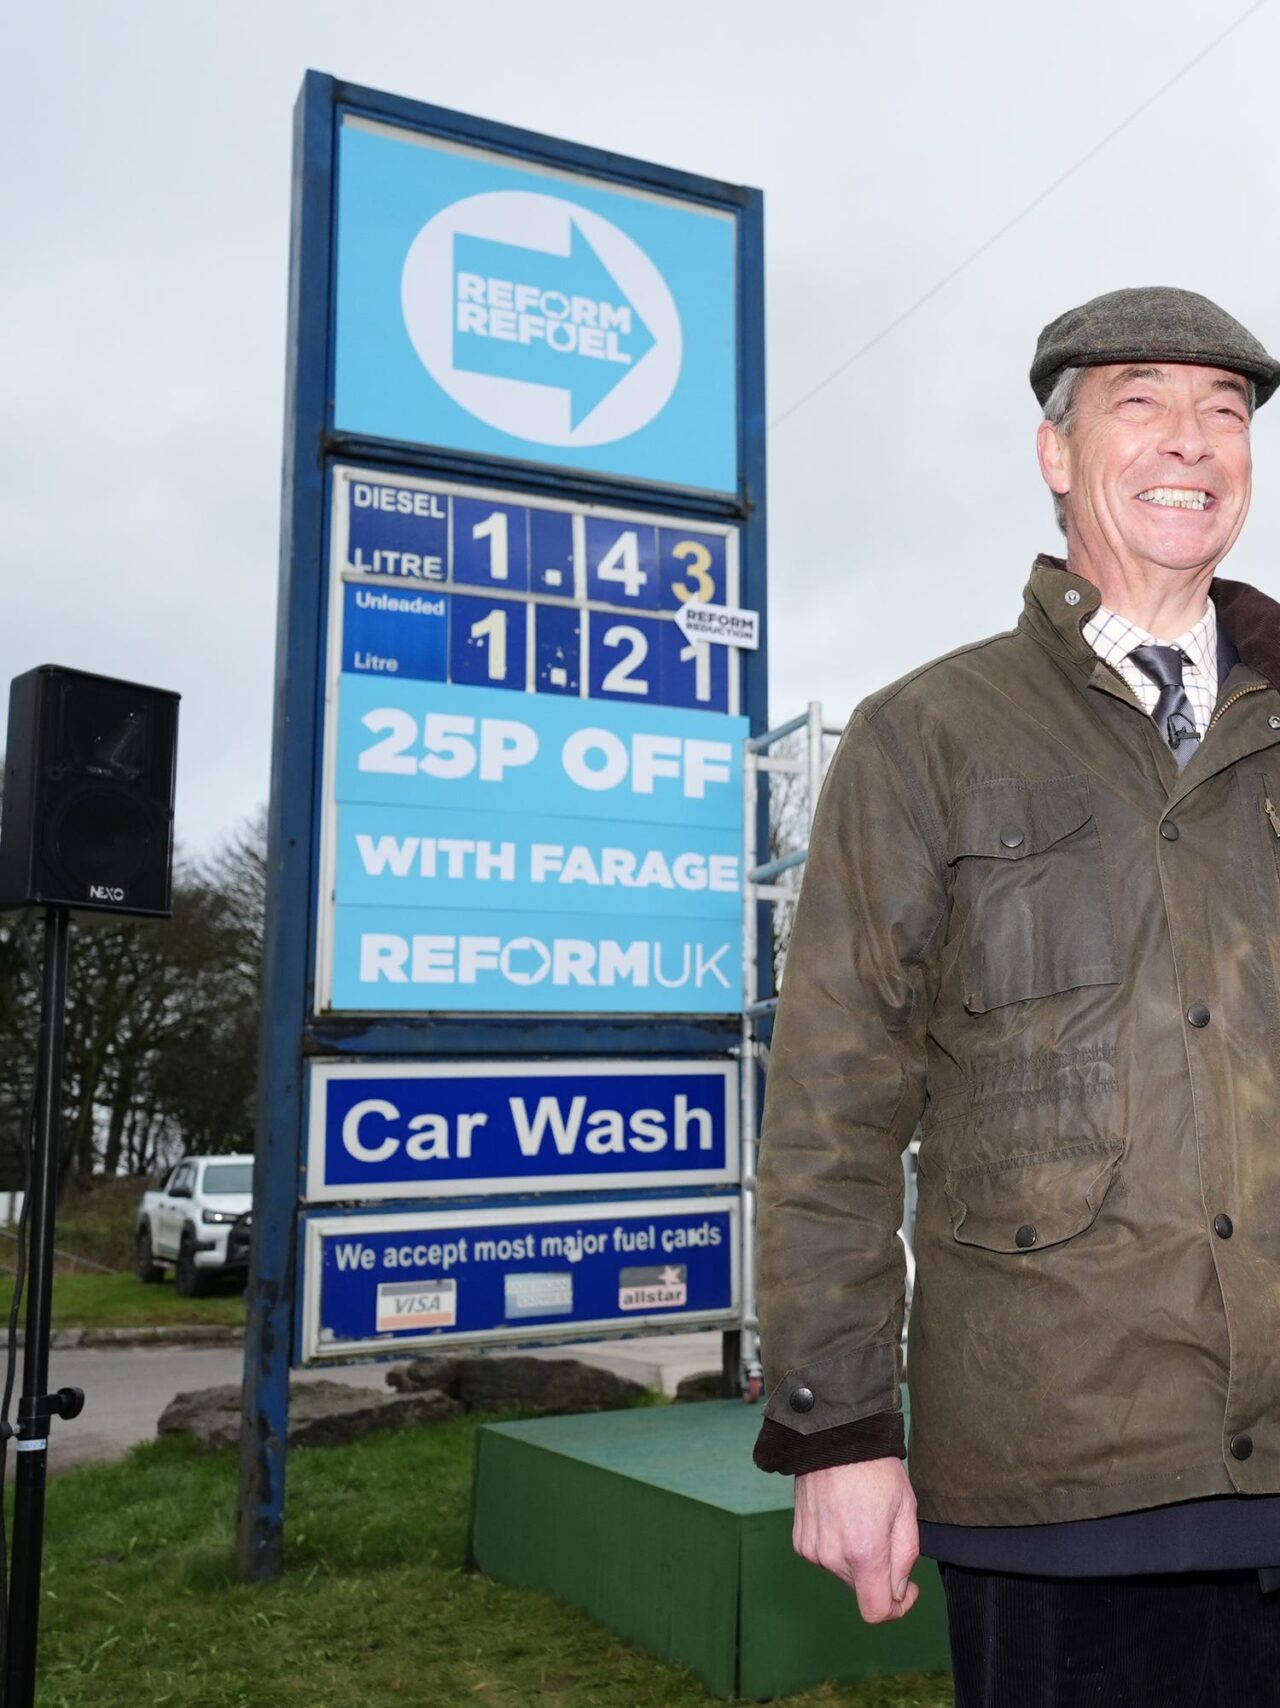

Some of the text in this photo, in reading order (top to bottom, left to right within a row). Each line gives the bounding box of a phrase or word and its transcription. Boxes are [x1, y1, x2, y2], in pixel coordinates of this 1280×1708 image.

[457, 271, 631, 333] REFORM
[457, 301, 631, 364] REFUEL
[354, 484, 445, 519] DIESEL
[354, 548, 443, 580] LITRE
[356, 591, 444, 616] Unleaded
[686, 609, 754, 631] REFORM
[686, 621, 753, 640] REDUCTION
[354, 651, 398, 672] Litre
[358, 707, 732, 799] 25P OFF
[355, 833, 739, 892] WITH FARAGE
[90, 885, 124, 900] NEXO
[341, 1094, 713, 1163] Car Wash
[335, 1222, 721, 1271] We accept most major fuel cards
[394, 1296, 441, 1314] VISA
[622, 1287, 682, 1306] allstar
